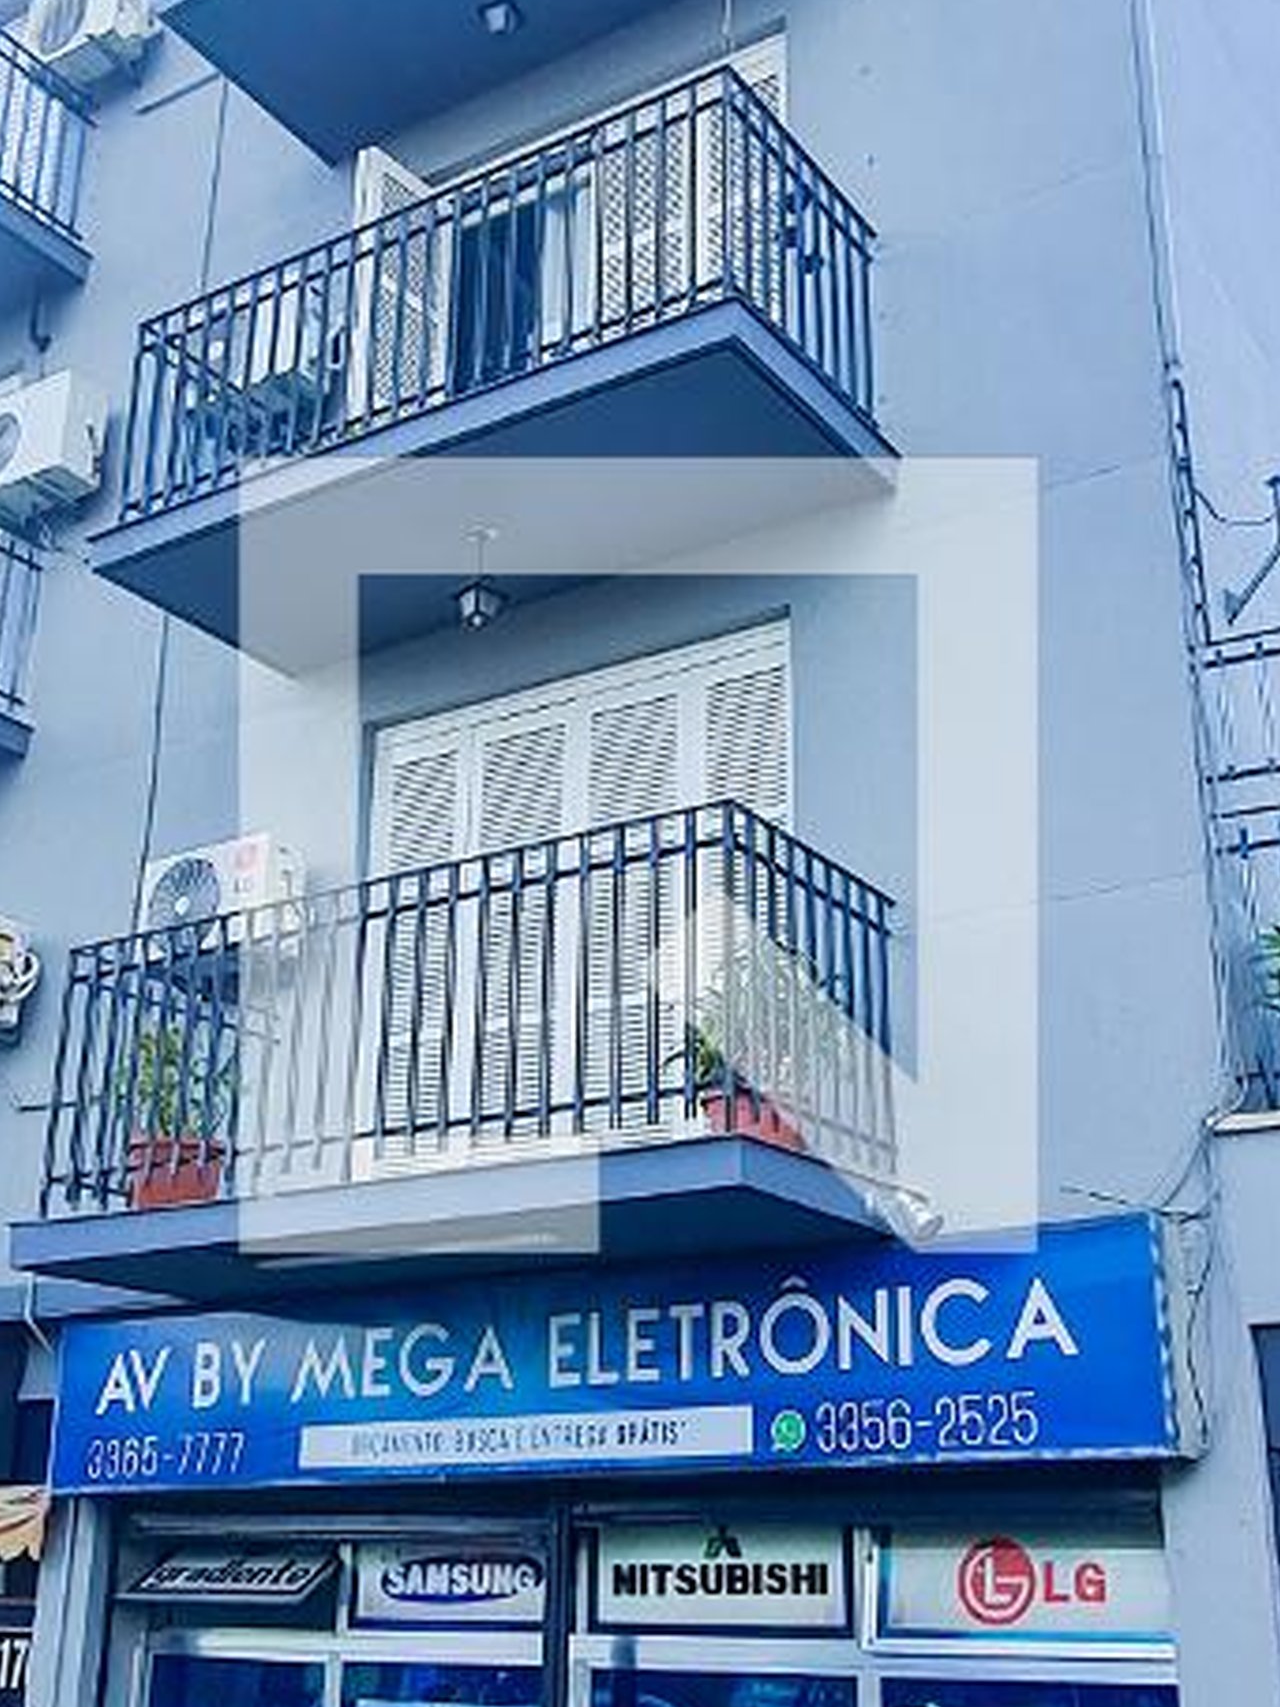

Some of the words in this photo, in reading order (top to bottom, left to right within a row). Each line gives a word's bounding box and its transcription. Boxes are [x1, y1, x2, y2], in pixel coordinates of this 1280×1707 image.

[96, 1346, 172, 1415] AV
[192, 1337, 266, 1409] BY
[290, 1323, 514, 1404] MEGA
[548, 1274, 1079, 1389] ELETRÔNICA
[817, 1390, 1039, 1454] 3356-2525
[86, 1432, 246, 1479] 3365-7777
[386, 1562, 536, 1597] SAMSUNG
[1044, 1562, 1106, 1603] LG
